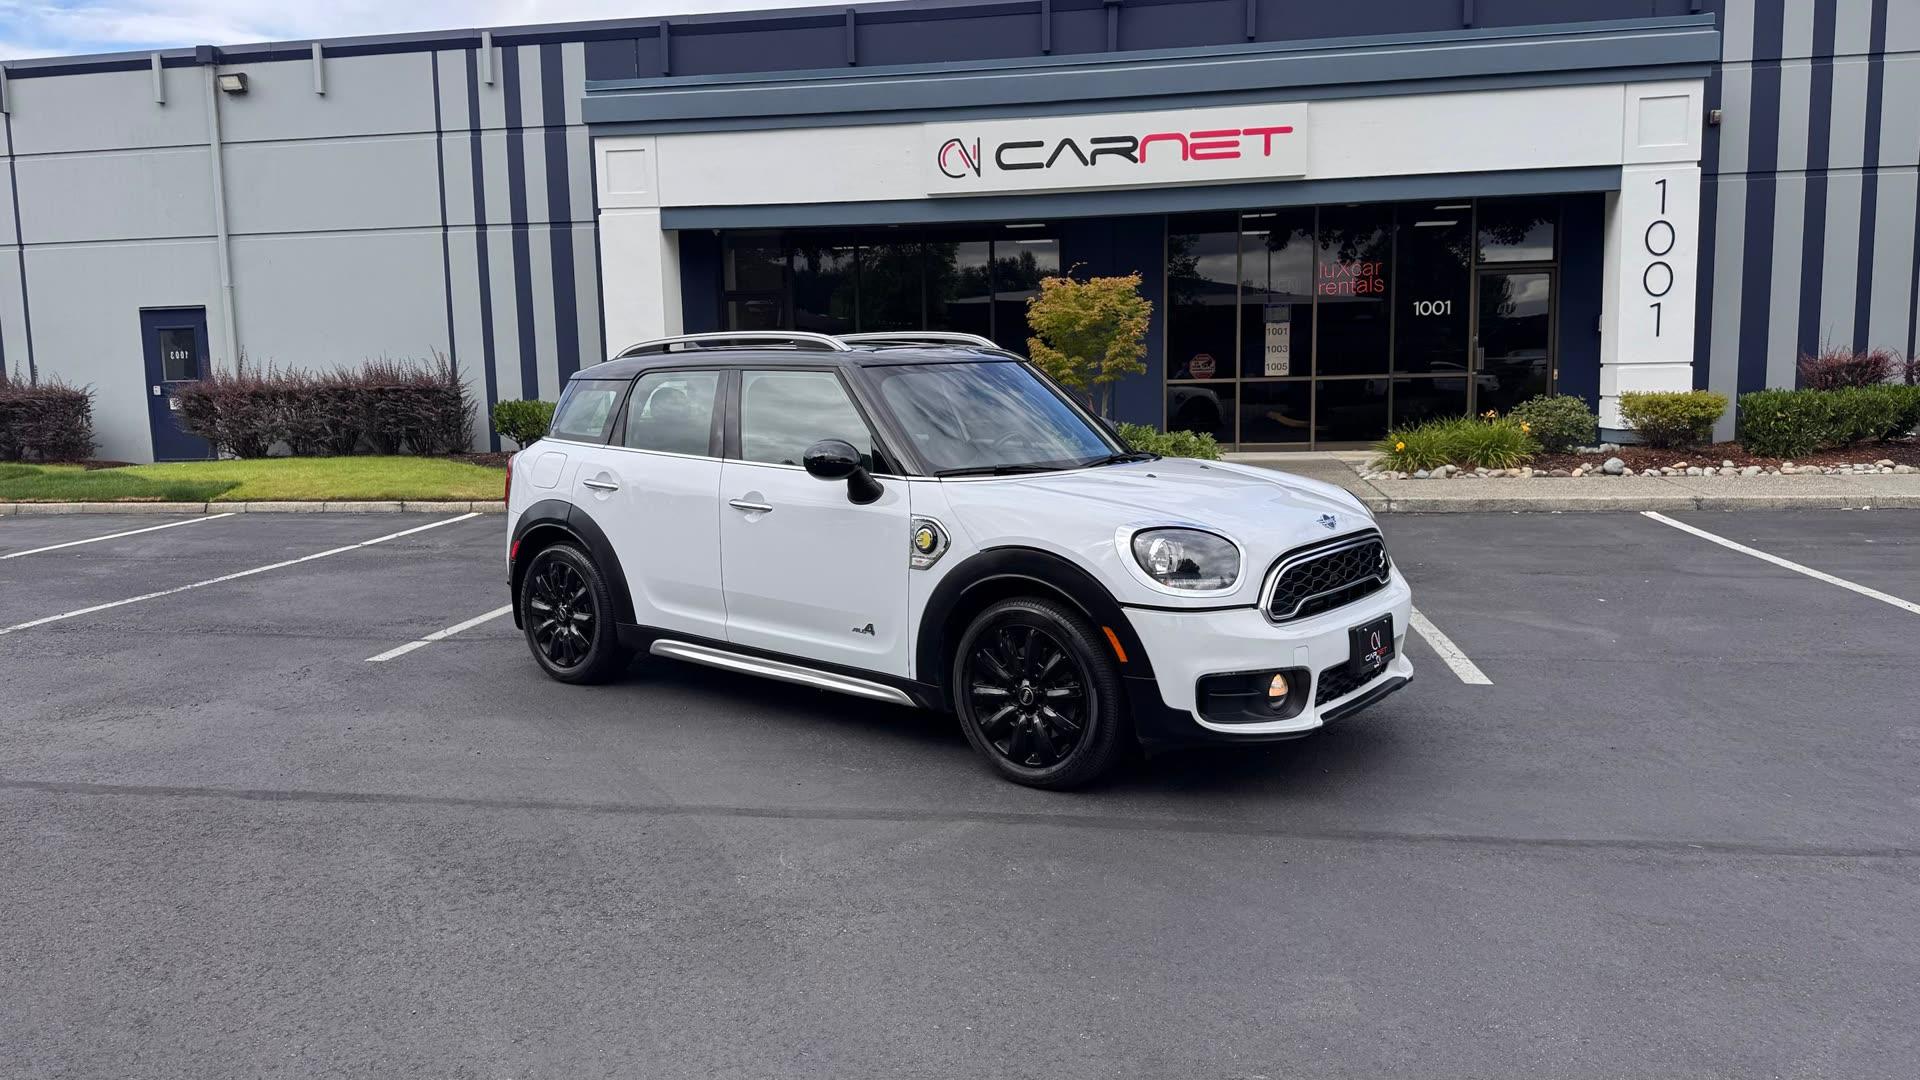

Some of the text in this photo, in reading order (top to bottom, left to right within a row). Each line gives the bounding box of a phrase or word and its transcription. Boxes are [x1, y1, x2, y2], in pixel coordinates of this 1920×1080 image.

[995, 125, 1293, 171] CARNET
[1643, 178, 1675, 337] 1001
[1318, 276, 1384, 295] rentals
[1413, 300, 1451, 316] 1001
[1266, 328, 1288, 336] 1001
[1266, 345, 1288, 353] 1003
[1266, 363, 1288, 371] 1005
